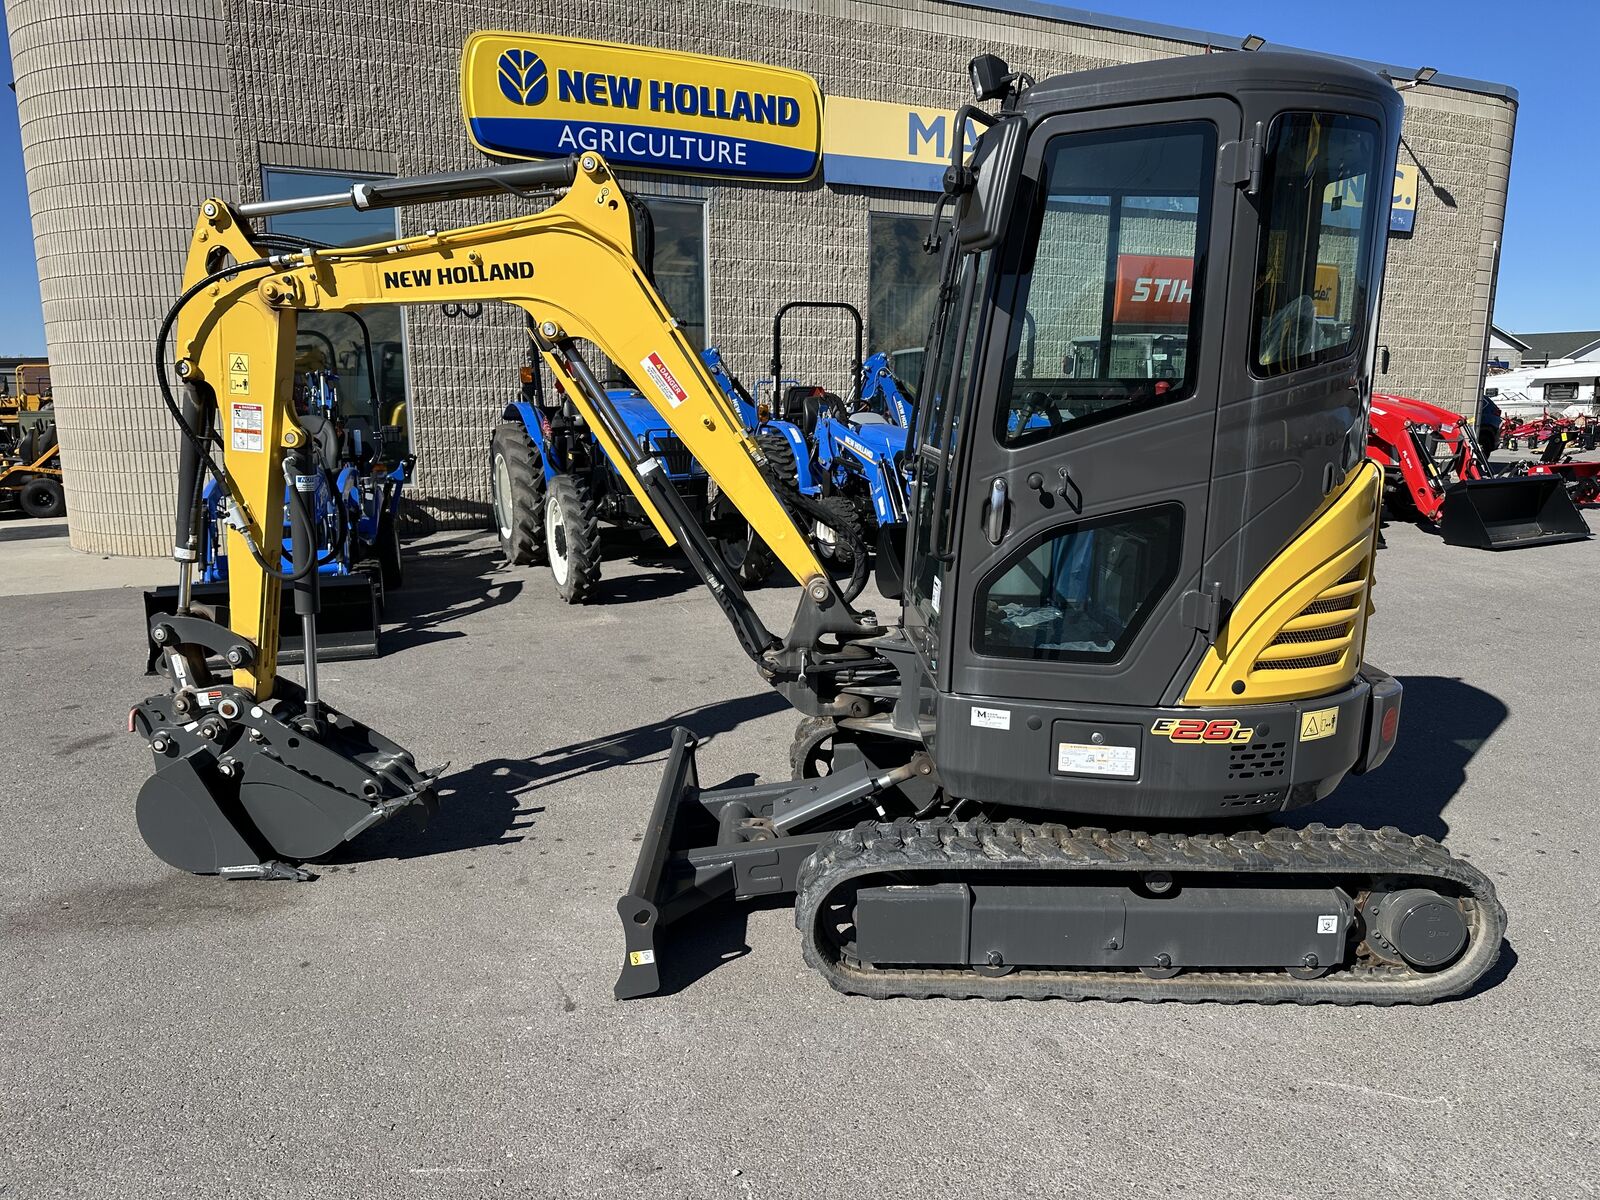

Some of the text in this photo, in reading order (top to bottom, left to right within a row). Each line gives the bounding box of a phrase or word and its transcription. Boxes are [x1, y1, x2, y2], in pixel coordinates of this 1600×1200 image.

[558, 69, 800, 126] NEW HOLLAND
[558, 125, 747, 165] AGRICULTURE
[384, 261, 535, 289] NEW HOLLAND
[659, 367, 681, 394] DANGER
[1153, 719, 1252, 741] E26C
